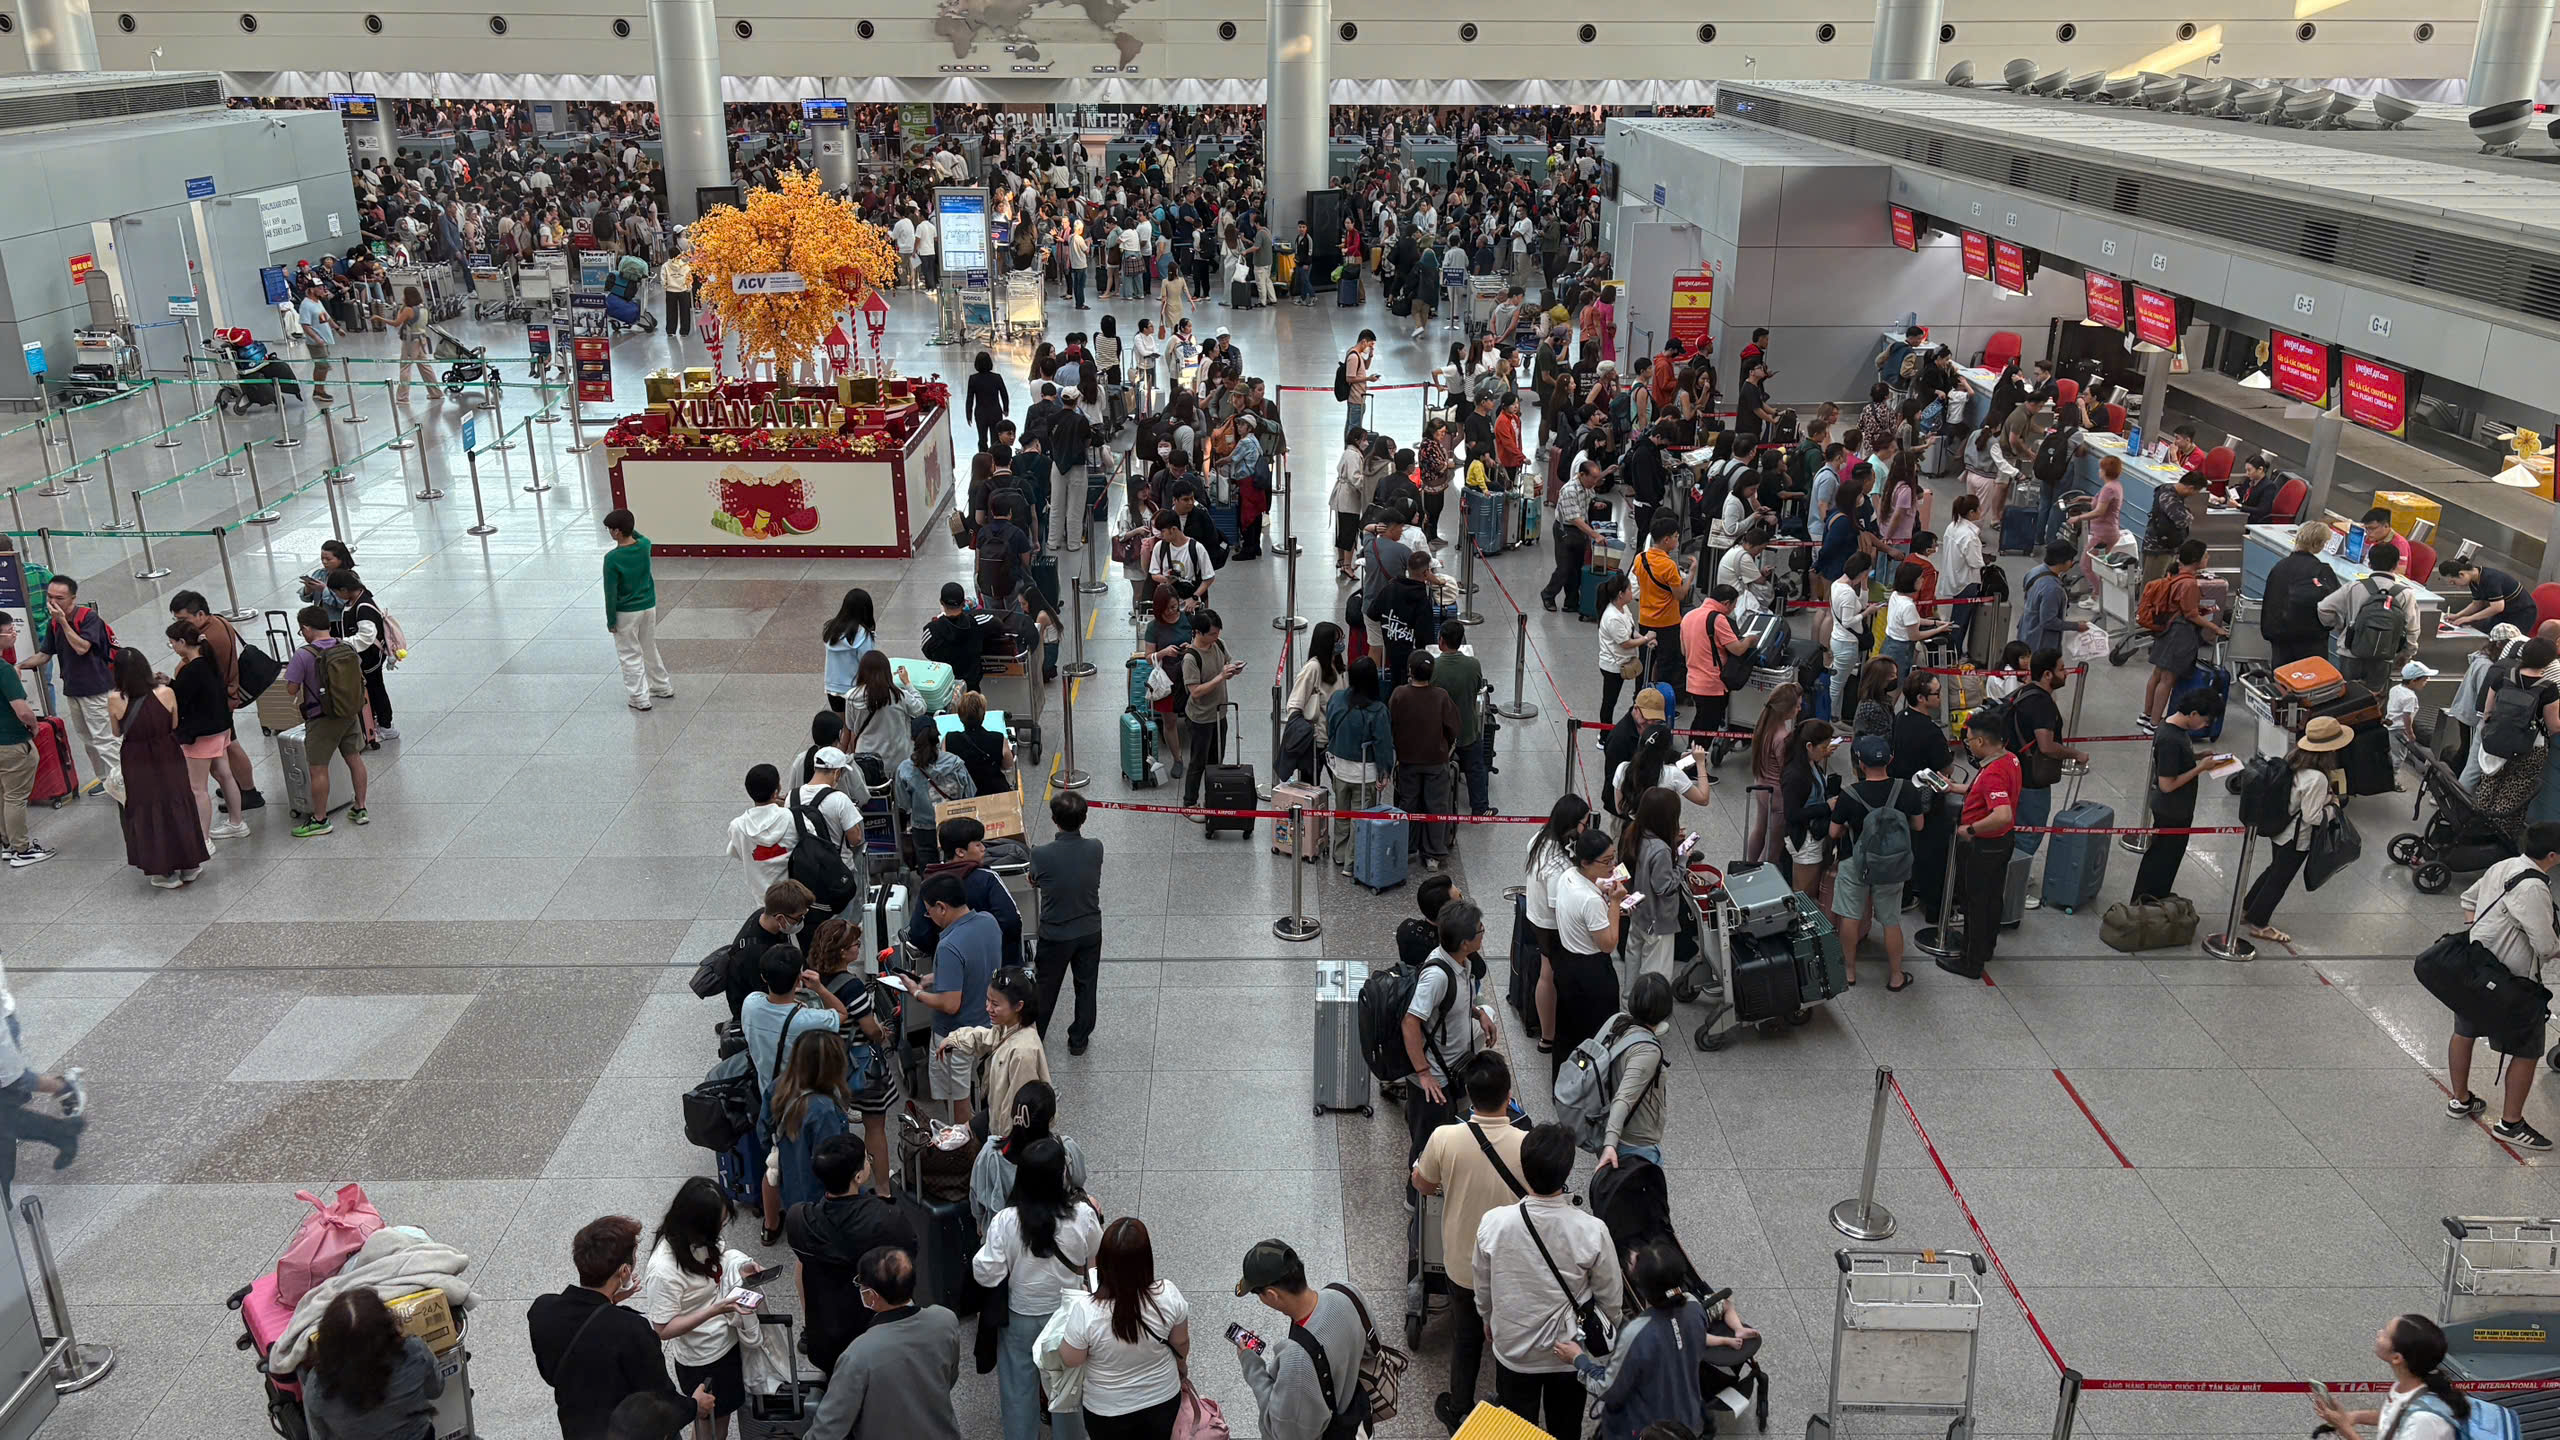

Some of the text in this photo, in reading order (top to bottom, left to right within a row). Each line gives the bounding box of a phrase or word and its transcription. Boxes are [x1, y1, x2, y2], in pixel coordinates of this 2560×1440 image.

[2103, 241, 2115, 254] G-7
[738, 277, 767, 289] ACV
[2297, 296, 2313, 312] G-5
[2372, 317, 2389, 334] G-4
[667, 391, 750, 429] XUÂN
[1101, 801, 1120, 809] TIA
[1181, 807, 1217, 815] INTERNATIONAL
[1388, 812, 1409, 820] TIA
[2103, 1382, 2262, 1392] CẢNG HÀNG KHÔNG QUỐC TẾ TÂN SƠN NHẤT
[2337, 1383, 2369, 1392] TIA
[2477, 1381, 2539, 1390] INTERNATIONAL
[2541, 1380, 2560, 1389] AIRP
